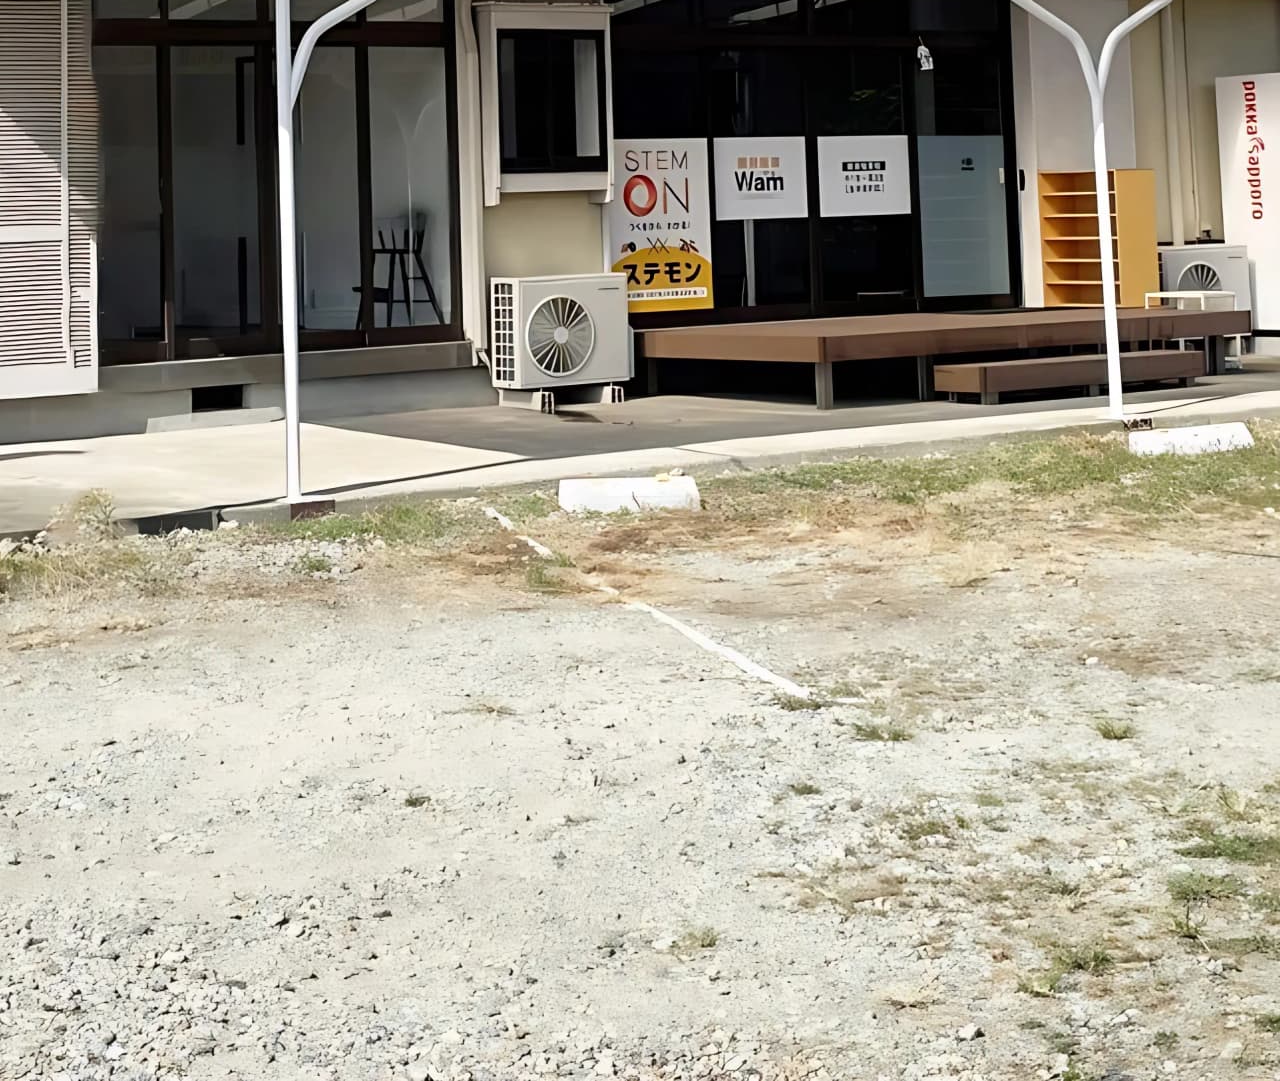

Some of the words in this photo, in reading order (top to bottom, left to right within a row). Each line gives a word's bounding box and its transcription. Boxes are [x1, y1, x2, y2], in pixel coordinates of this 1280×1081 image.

[624, 150, 688, 172] STEM
[735, 170, 785, 192] Wam
[623, 174, 689, 217] ON
[623, 262, 702, 285] ステモン
